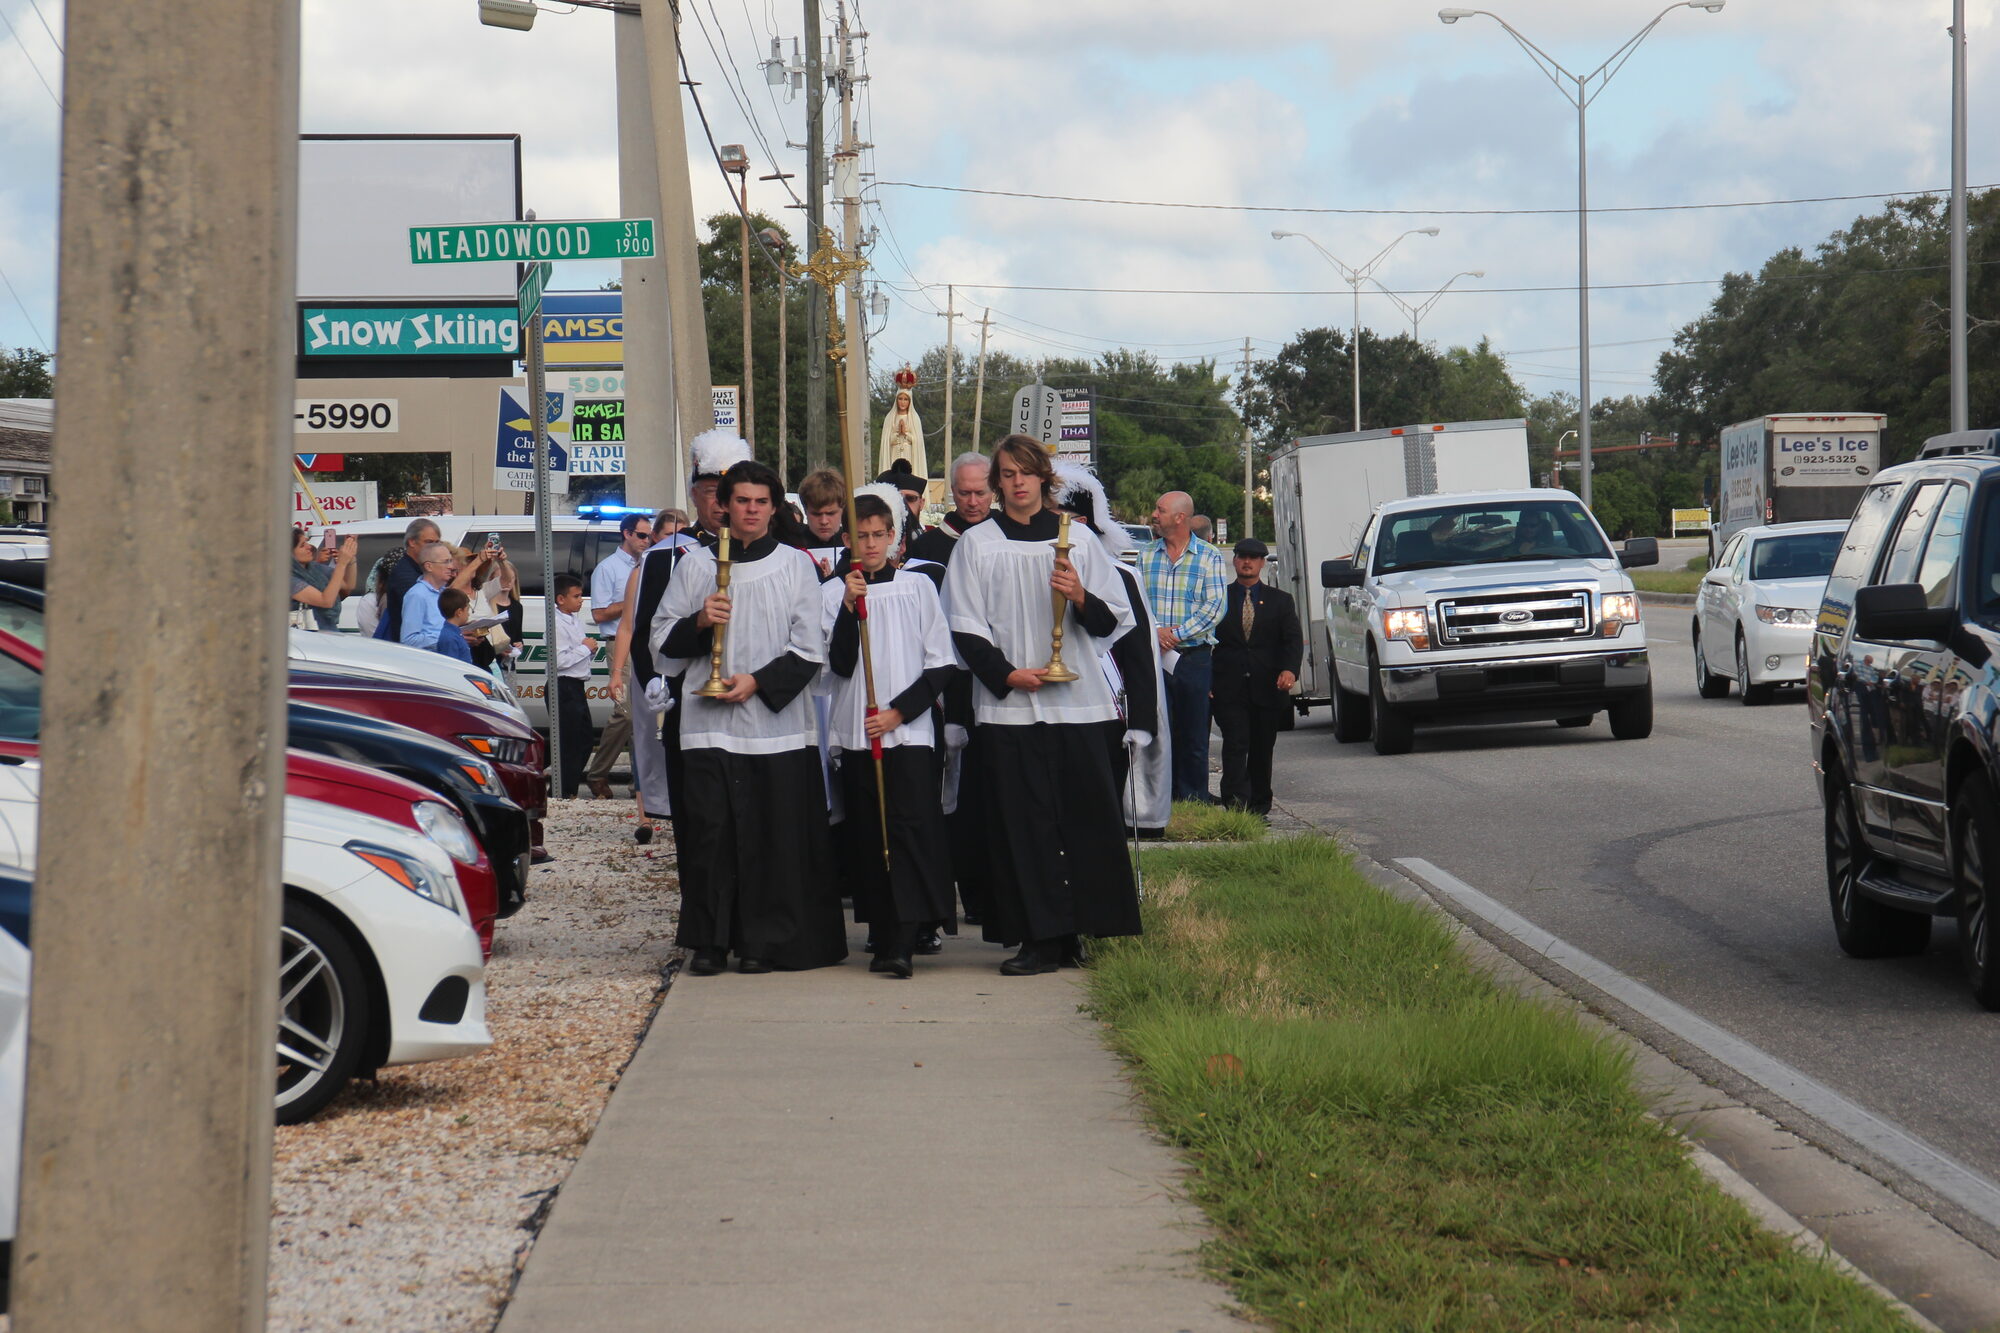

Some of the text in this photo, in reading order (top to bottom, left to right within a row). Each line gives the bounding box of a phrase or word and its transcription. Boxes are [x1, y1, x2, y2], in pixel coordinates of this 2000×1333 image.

[416, 222, 639, 260] MEADOWOOD ST
[616, 237, 650, 253] 1900
[307, 313, 518, 352] Snow Skiing
[568, 376, 625, 393] 590
[573, 401, 624, 419] CHAEL
[1062, 427, 1088, 435] THAI
[514, 436, 551, 450] Chrt
[1781, 437, 1869, 452] Lee's Ice
[507, 450, 526, 463] the
[569, 460, 604, 473] FUN
